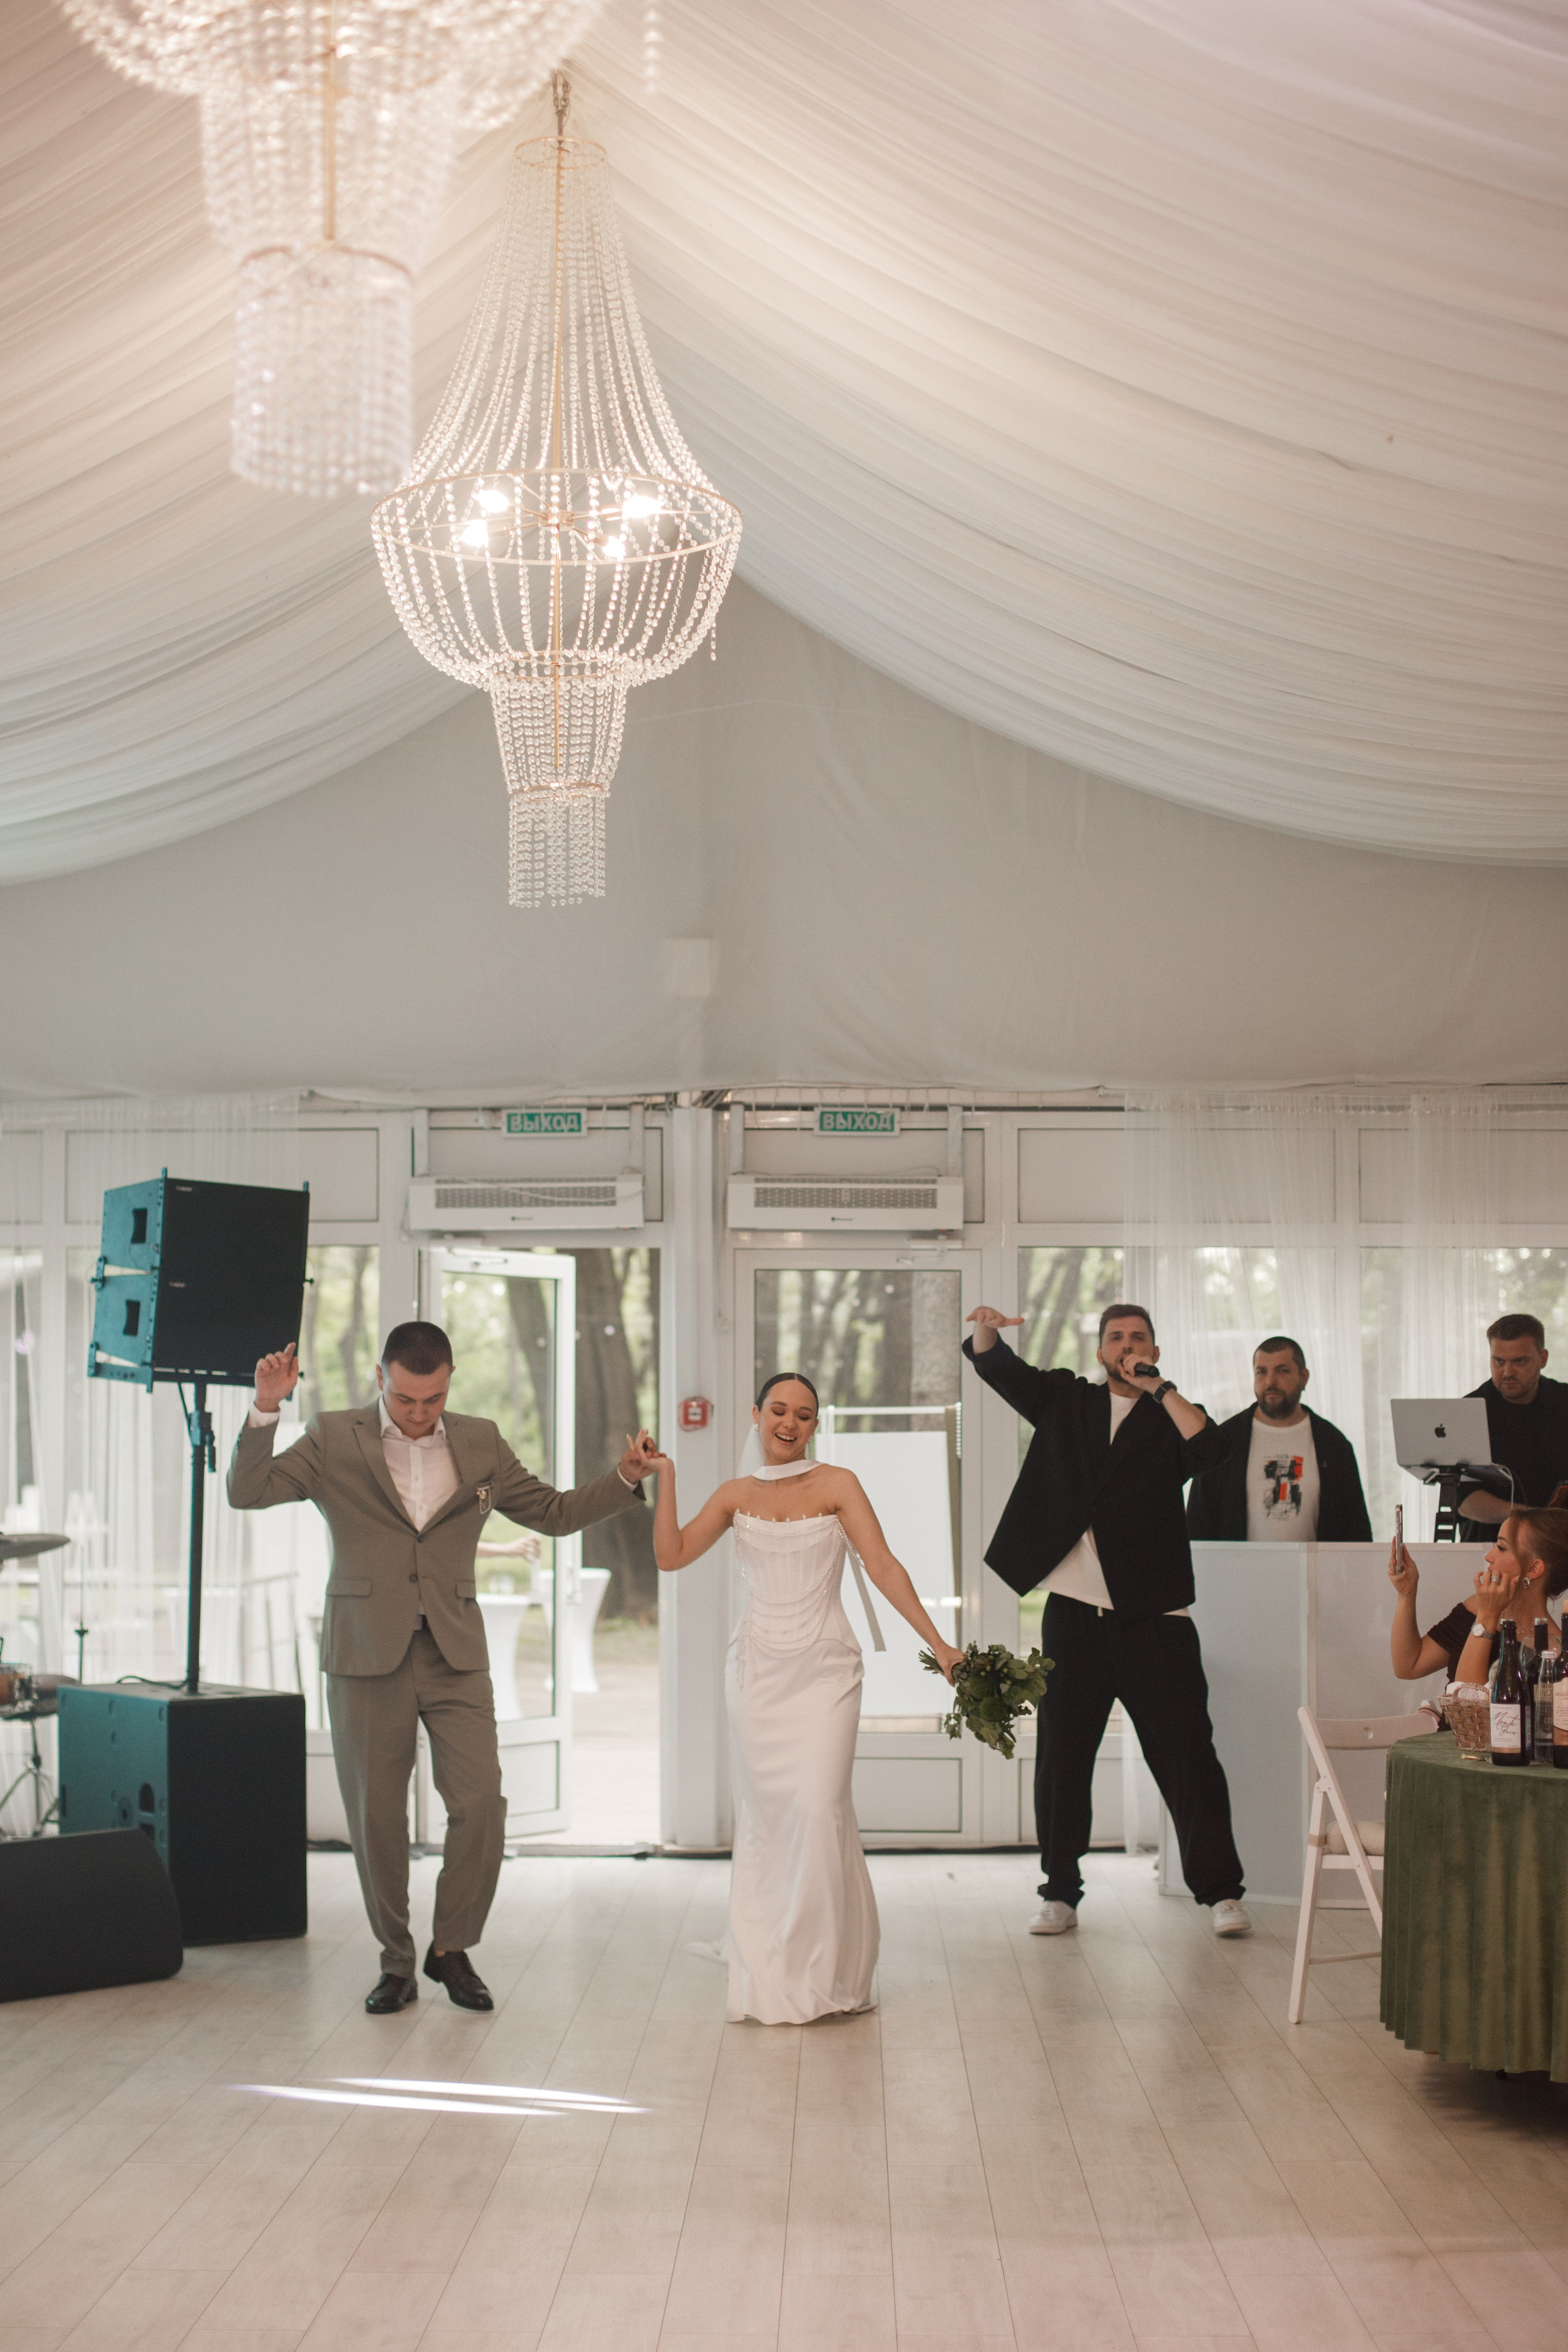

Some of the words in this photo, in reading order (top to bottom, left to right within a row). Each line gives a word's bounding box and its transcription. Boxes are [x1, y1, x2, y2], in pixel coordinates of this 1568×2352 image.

[511, 1114, 578, 1131] ВЫХОД
[823, 1114, 891, 1130] ВЫХОД
[1493, 1712, 1521, 1730] Monte
